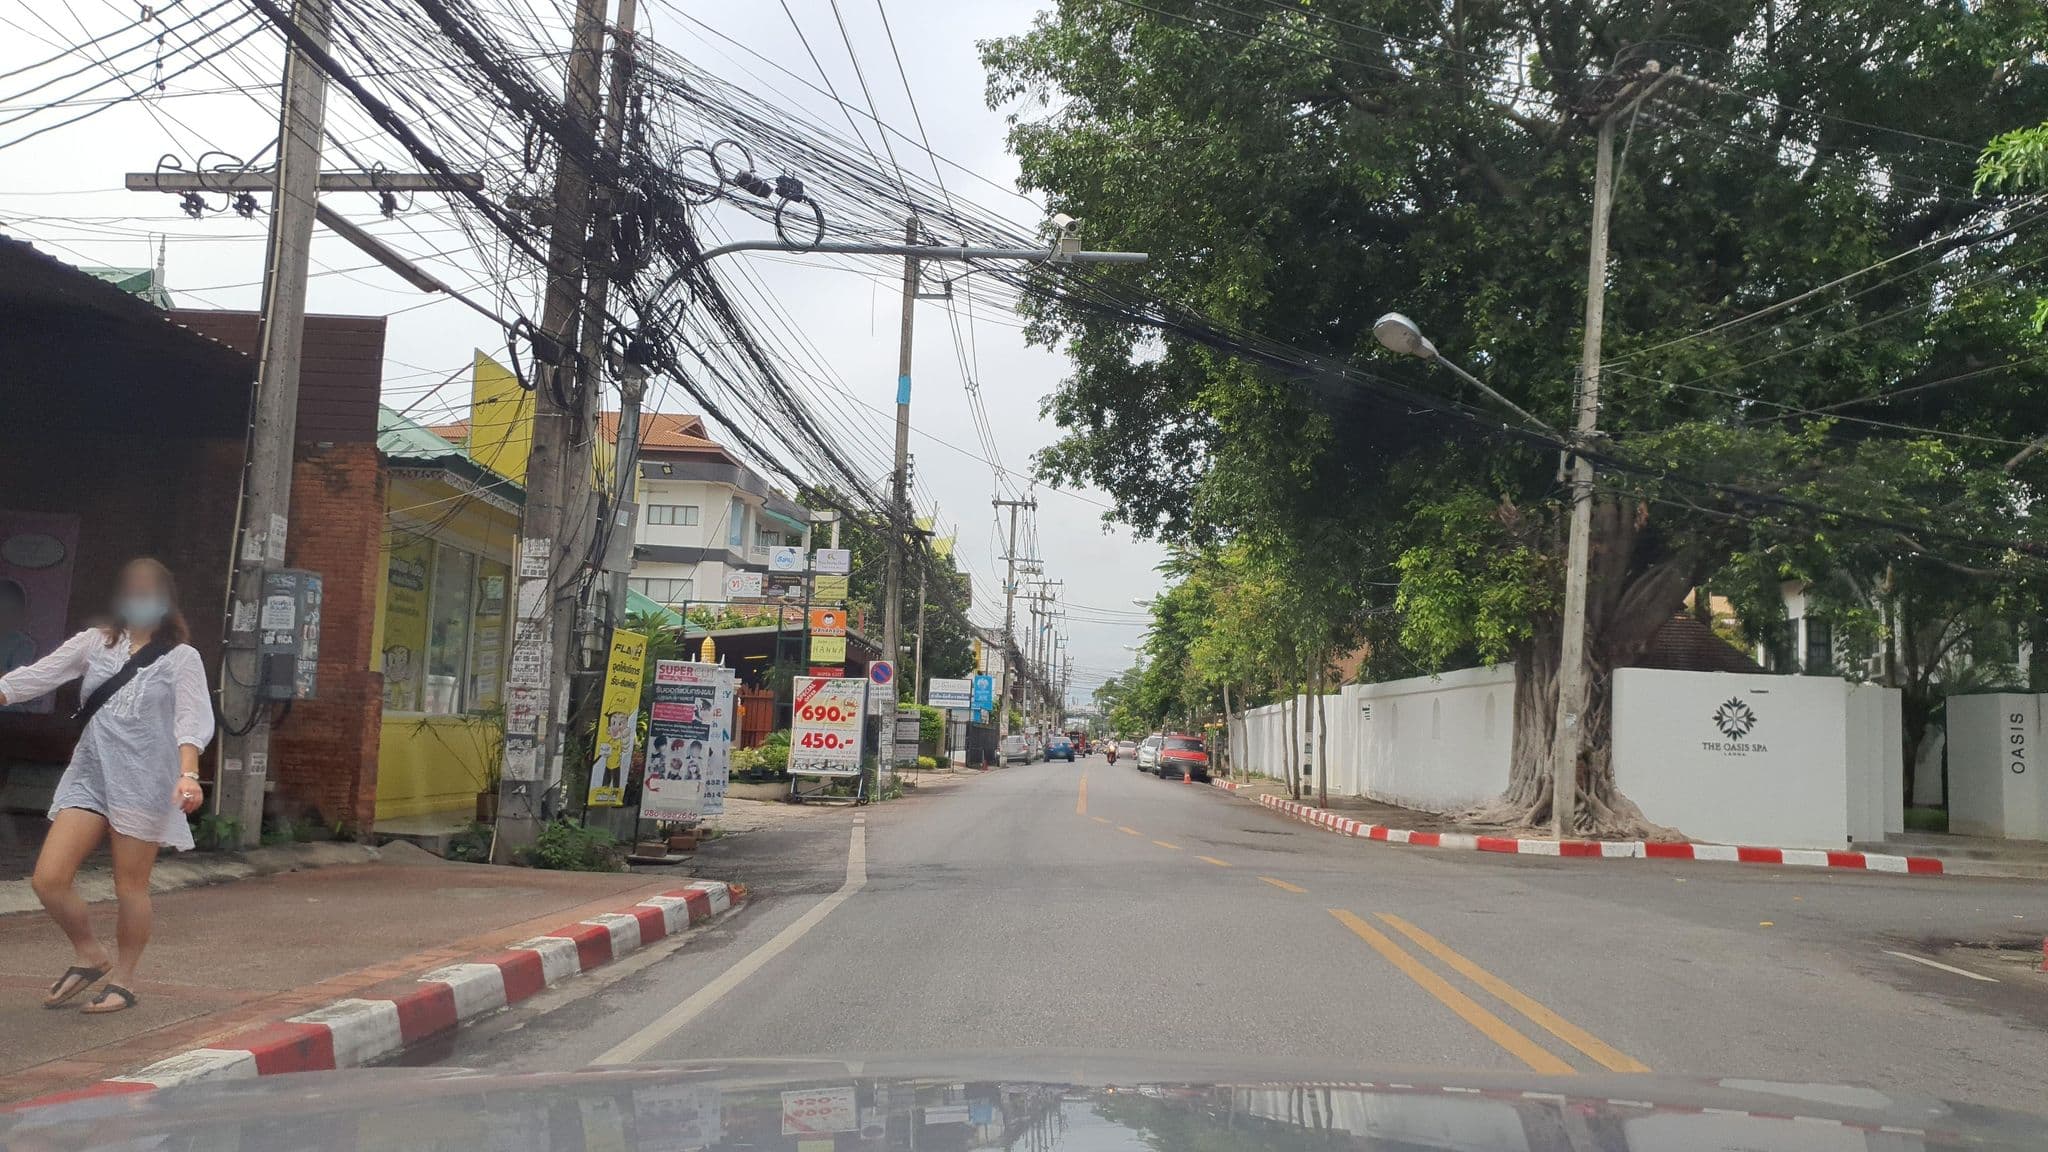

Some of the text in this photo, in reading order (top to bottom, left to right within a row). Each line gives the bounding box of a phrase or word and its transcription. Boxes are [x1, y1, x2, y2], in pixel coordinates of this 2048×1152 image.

[659, 664, 694, 676] SUPER
[801, 705, 856, 722] 690.-
[800, 732, 854, 749] 450.-
[1702, 742, 1768, 752] THE OASIS SPA
[2010, 713, 2026, 774] OASIS
